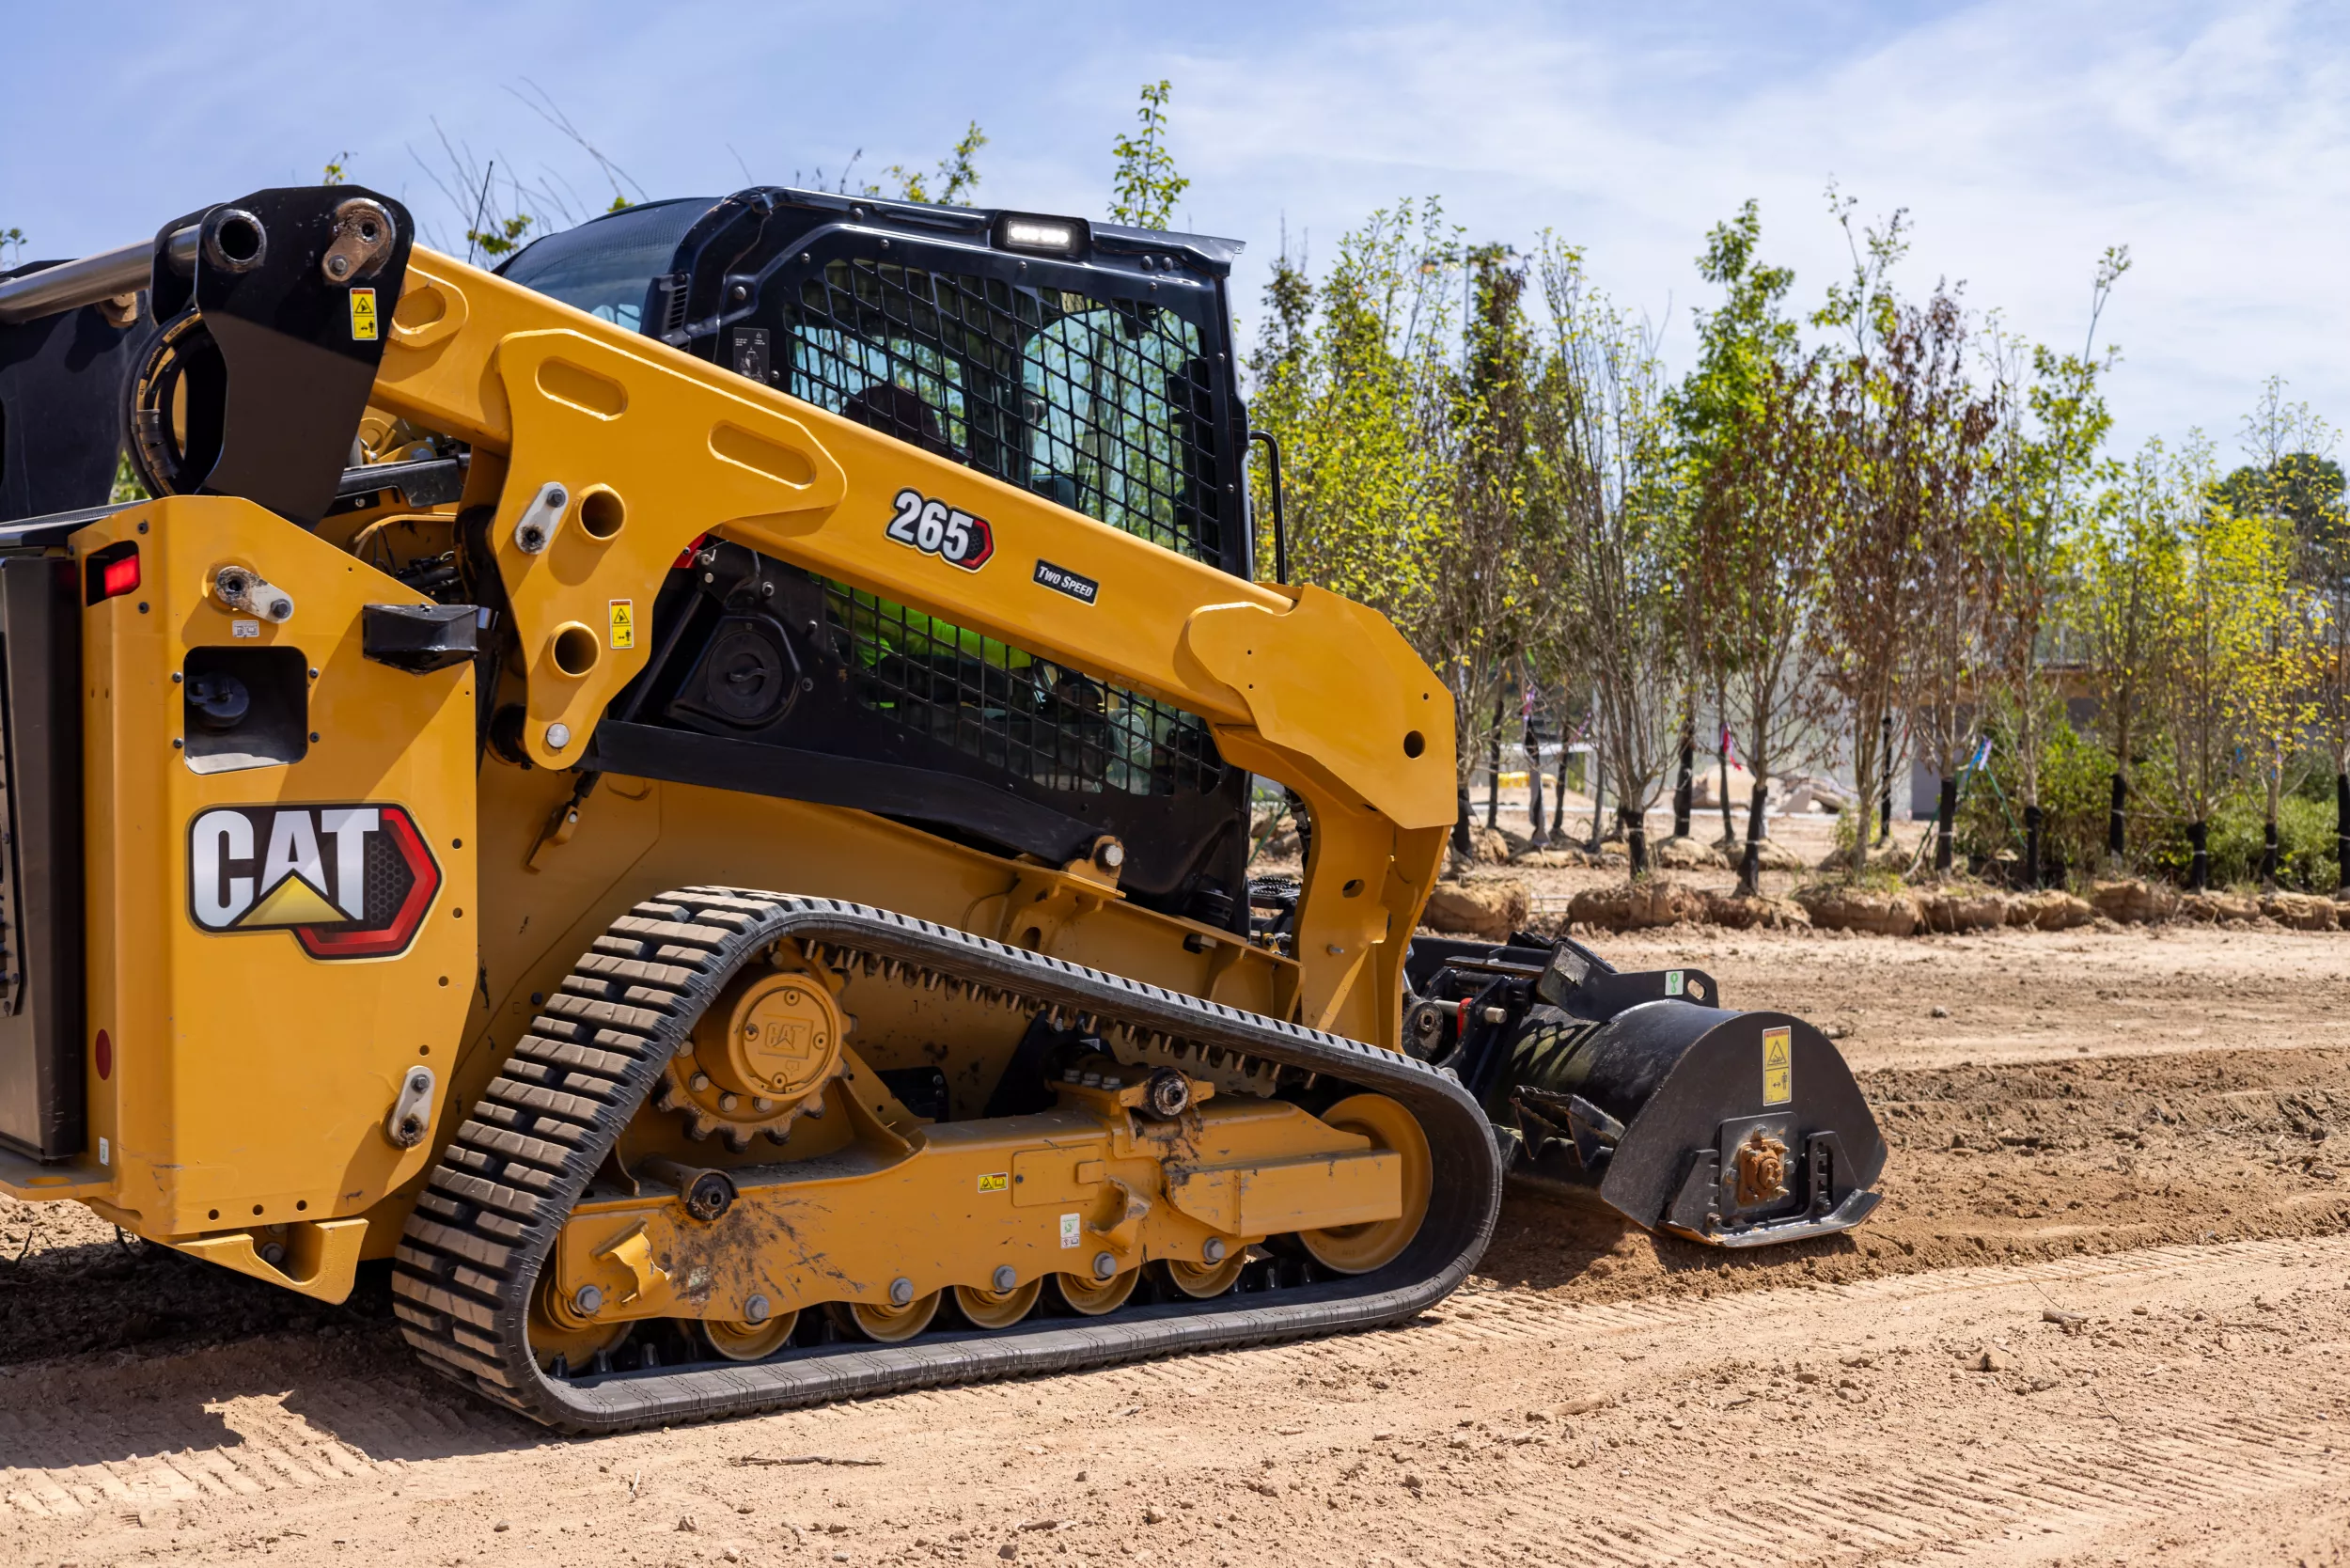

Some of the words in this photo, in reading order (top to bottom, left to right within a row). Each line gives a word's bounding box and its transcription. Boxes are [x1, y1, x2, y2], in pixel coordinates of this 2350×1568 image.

[888, 491, 975, 561] 265
[1037, 565, 1061, 585] TWO
[1060, 575, 1094, 598] SPEED
[193, 808, 380, 928] CAT
[764, 1022, 807, 1050] CAT
